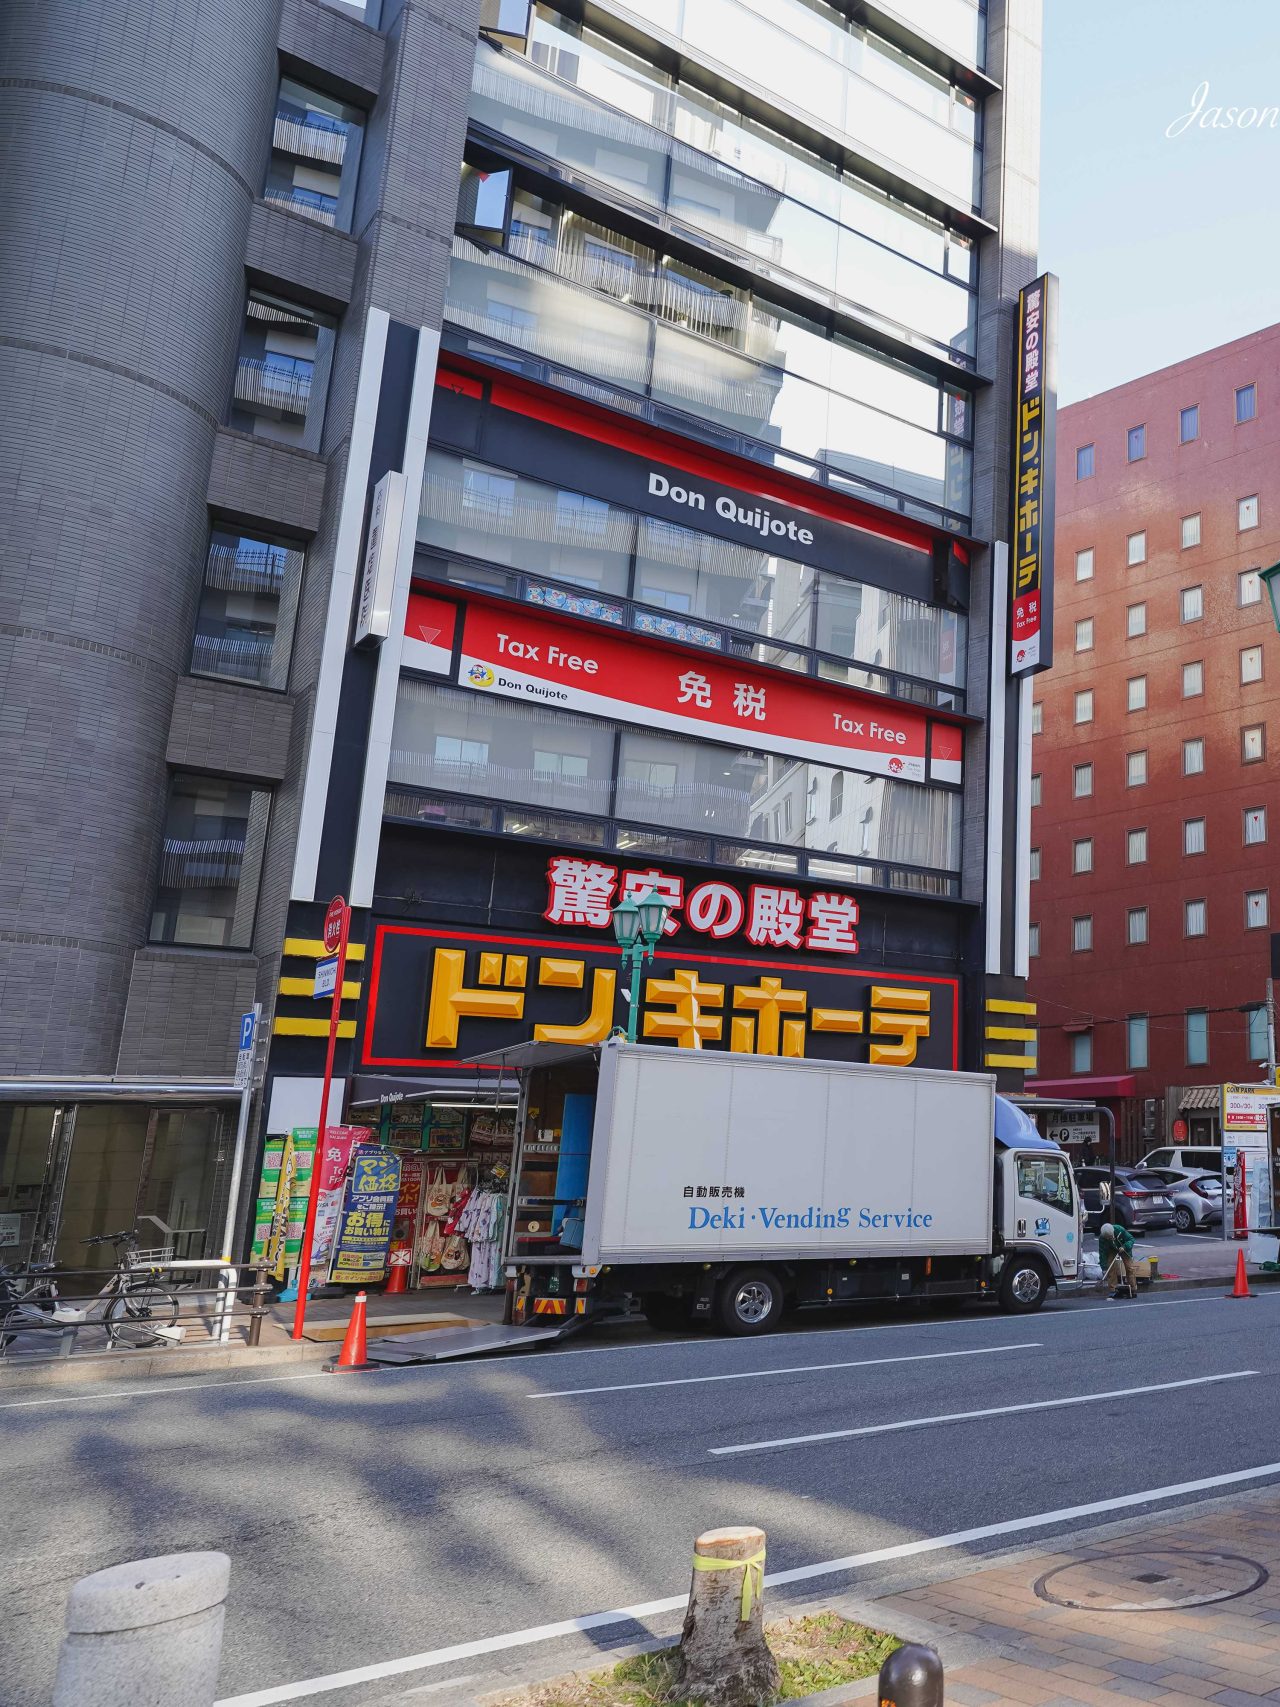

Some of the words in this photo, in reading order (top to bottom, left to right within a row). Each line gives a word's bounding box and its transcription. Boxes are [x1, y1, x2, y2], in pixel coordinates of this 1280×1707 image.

[1024, 291, 1042, 393] 驚安の殿堂
[648, 472, 706, 511] Don
[715, 496, 815, 545] Quijote
[496, 632, 540, 664] Tax
[548, 646, 599, 675] Free
[497, 676, 522, 693] Don
[525, 682, 568, 701] Quijote
[832, 712, 864, 737] Tax
[869, 722, 907, 746] Free
[242, 1017, 252, 1047] P
[358, 1173, 398, 1191] 価格
[683, 1186, 745, 1198] 自動販売機
[858, 1207, 933, 1229] Service
